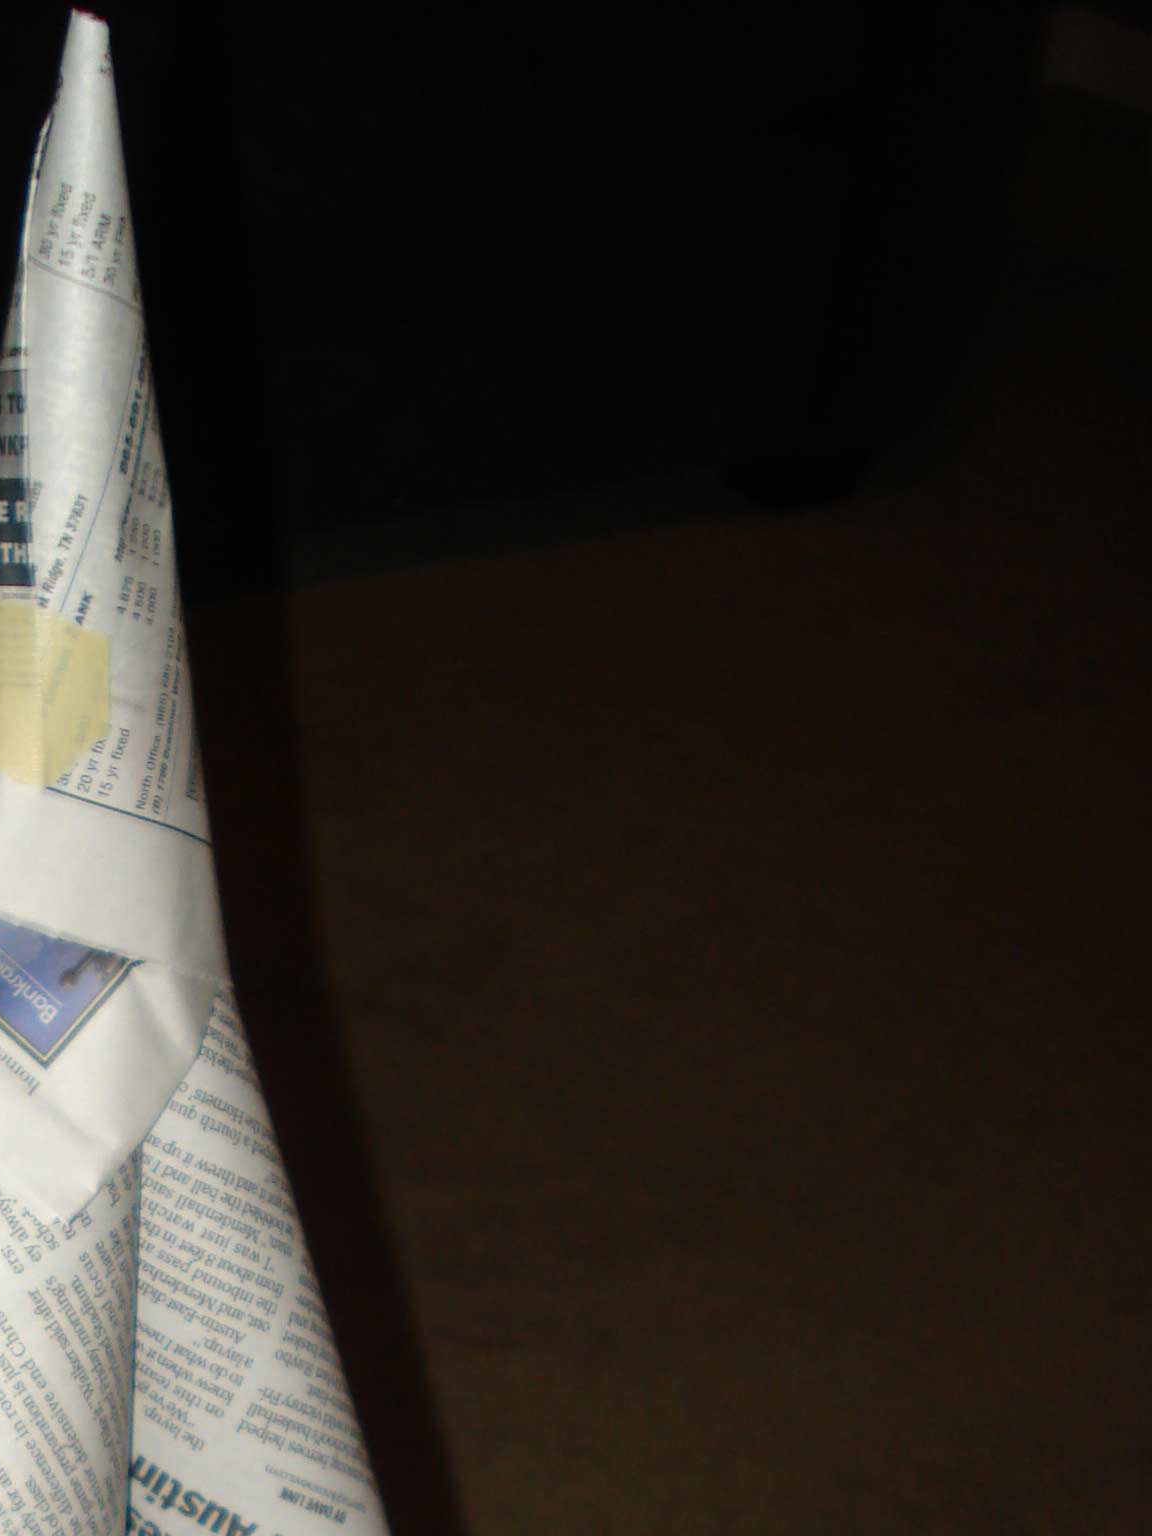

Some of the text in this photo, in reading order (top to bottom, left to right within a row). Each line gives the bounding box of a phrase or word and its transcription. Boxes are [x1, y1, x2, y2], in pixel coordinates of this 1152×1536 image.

[56, 531, 75, 551] TN
[69, 589, 96, 626] ANK
[76, 734, 107, 793] 20 yr fix
[96, 726, 131, 799] 15 yr fixed
[133, 773, 156, 811] North
[196, 1112, 243, 1146] fourth
[160, 1164, 221, 1203] ball and
[173, 1191, 262, 1244] Mendenhall
[198, 1222, 263, 1263] was just
[133, 1258, 219, 1311] Mendenha
[155, 1244, 256, 1308] inbound pass
[214, 1256, 256, 1285] about
[22, 1285, 57, 1325] after
[39, 1271, 98, 1346] morning's
[163, 1295, 248, 1346] Austin-East
[19, 1356, 50, 1392] end
[168, 1343, 209, 1373] what
[6, 1378, 28, 1399] is
[8, 1418, 31, 1441] in
[12, 1392, 83, 1480] preparation
[178, 1429, 207, 1452] the
[234, 1416, 287, 1452] helped
[16, 1437, 80, 1518] difference
[0, 1485, 28, 1514] for
